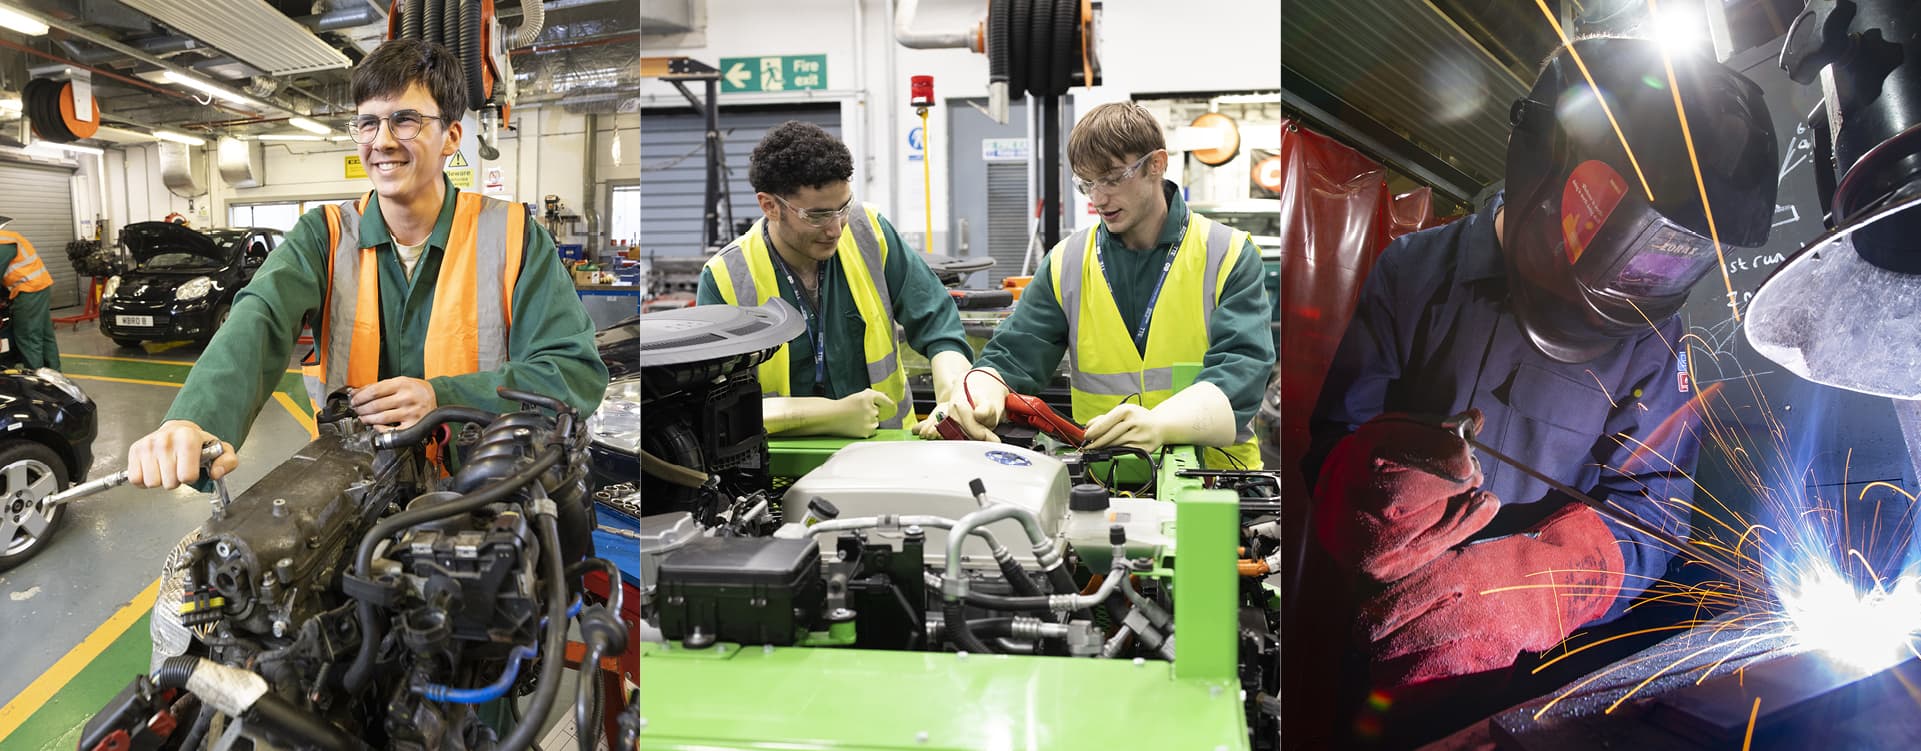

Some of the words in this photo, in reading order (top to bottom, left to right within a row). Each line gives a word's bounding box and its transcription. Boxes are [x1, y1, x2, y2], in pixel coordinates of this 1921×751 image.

[793, 59, 819, 73] Fire
[794, 74, 819, 87] exit
[1753, 252, 1786, 268] run
